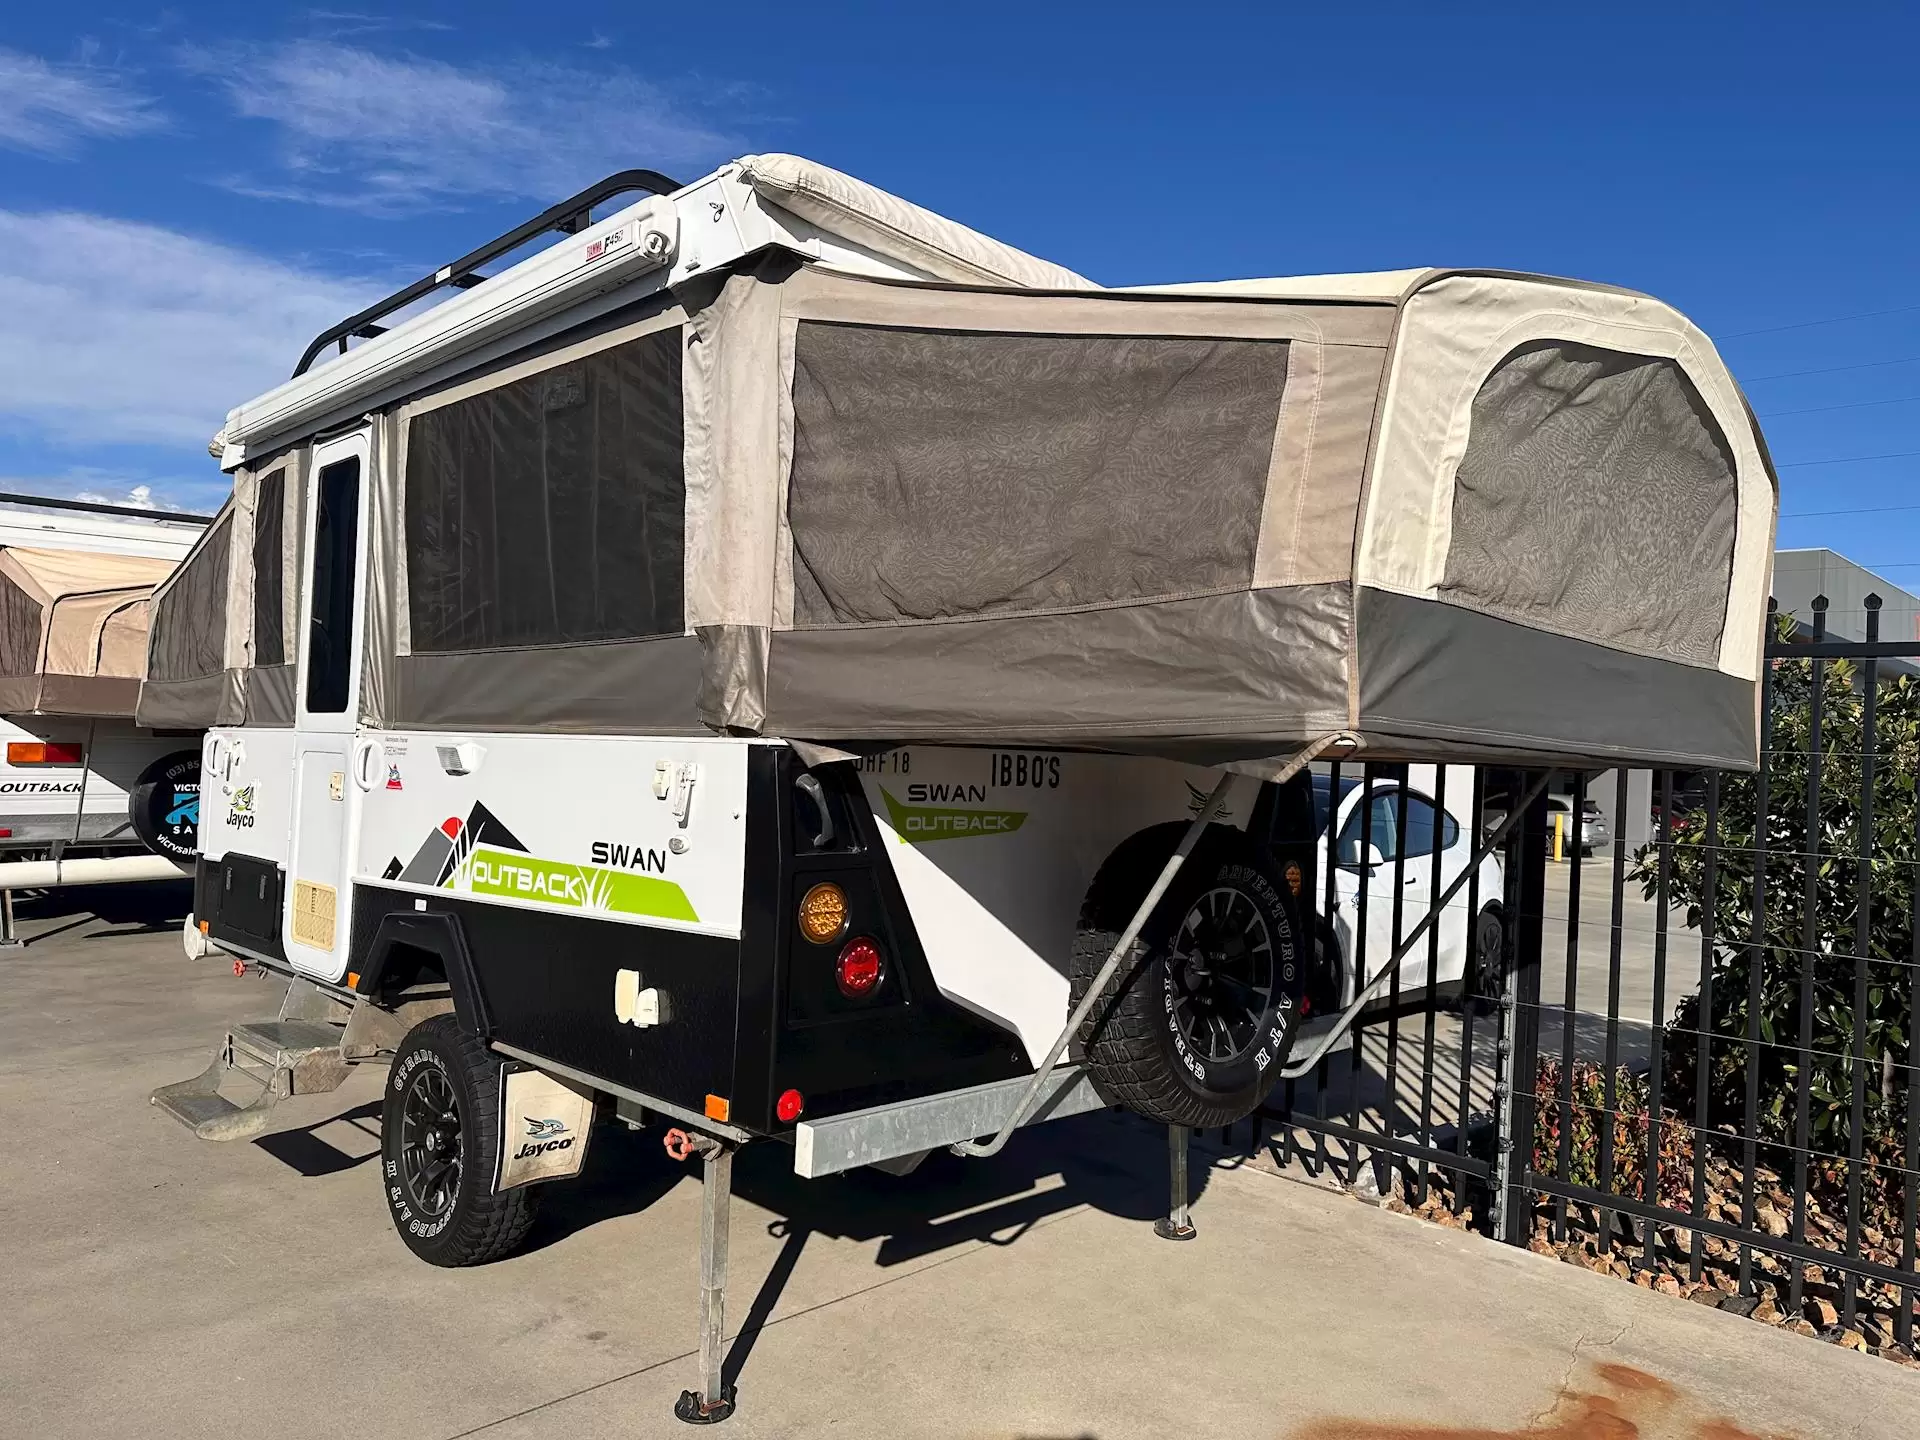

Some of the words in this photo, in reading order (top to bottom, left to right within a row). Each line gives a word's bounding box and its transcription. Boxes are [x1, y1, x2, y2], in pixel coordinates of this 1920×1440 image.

[165, 764, 186, 780] (03)
[892, 751, 911, 773] 18
[991, 752, 1061, 789] IBBO'S
[0, 782, 82, 793] OUTBACK
[908, 784, 986, 802] SWAN
[226, 809, 254, 830] Jayco
[906, 815, 1011, 832] OUTBACK
[592, 841, 667, 874] SWAN
[473, 860, 582, 902] OUTBACK
[513, 1138, 573, 1160] Jayco
